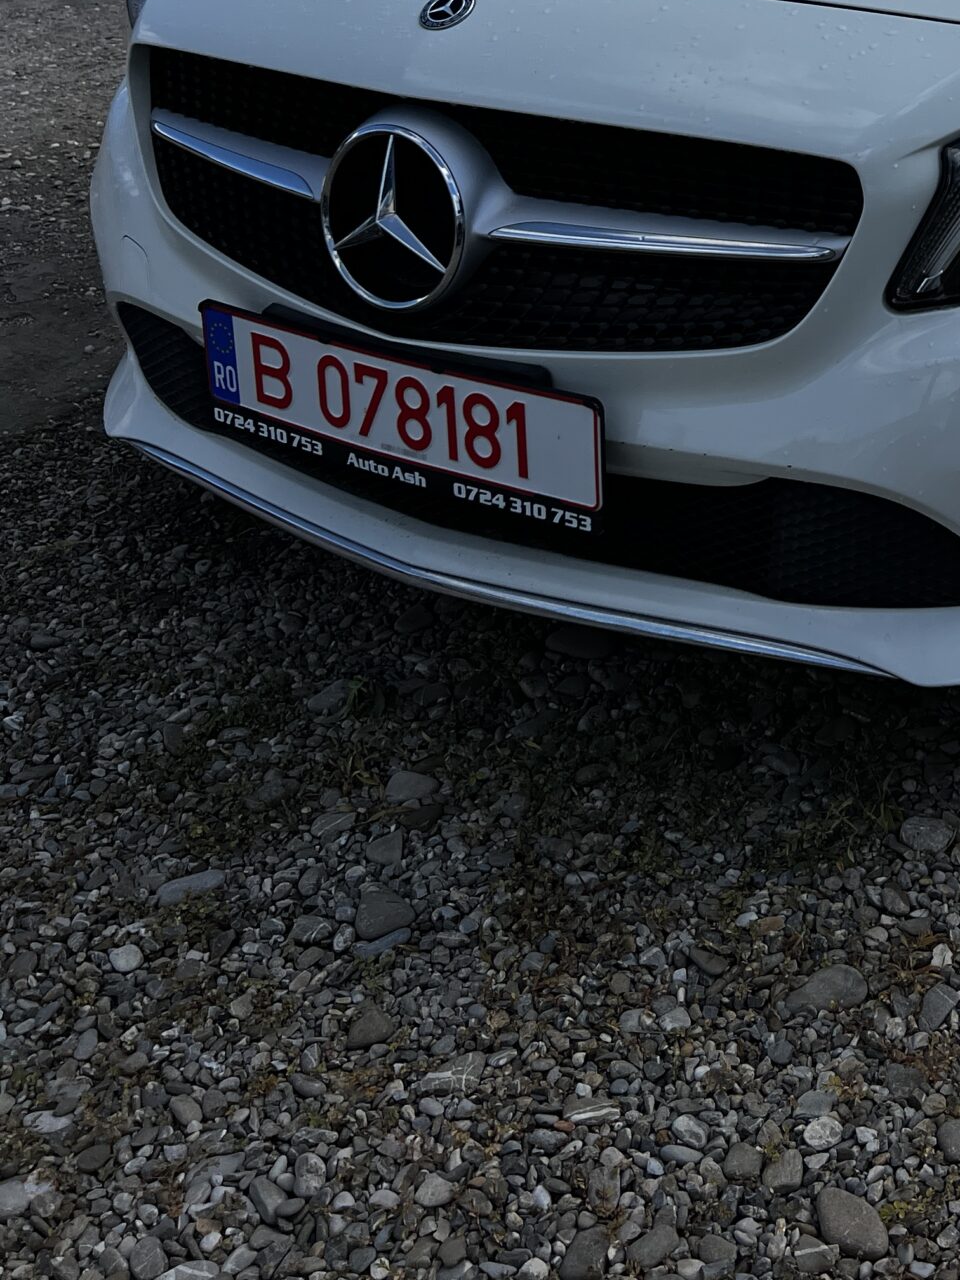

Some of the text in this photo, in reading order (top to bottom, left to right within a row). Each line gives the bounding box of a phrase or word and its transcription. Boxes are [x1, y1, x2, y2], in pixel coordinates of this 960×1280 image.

[212, 360, 238, 393] RO
[250, 331, 530, 480] B 078181
[213, 406, 324, 456] 0724 310 753
[346, 451, 427, 489] Auto Ash
[453, 482, 592, 532] 0724 310 753
